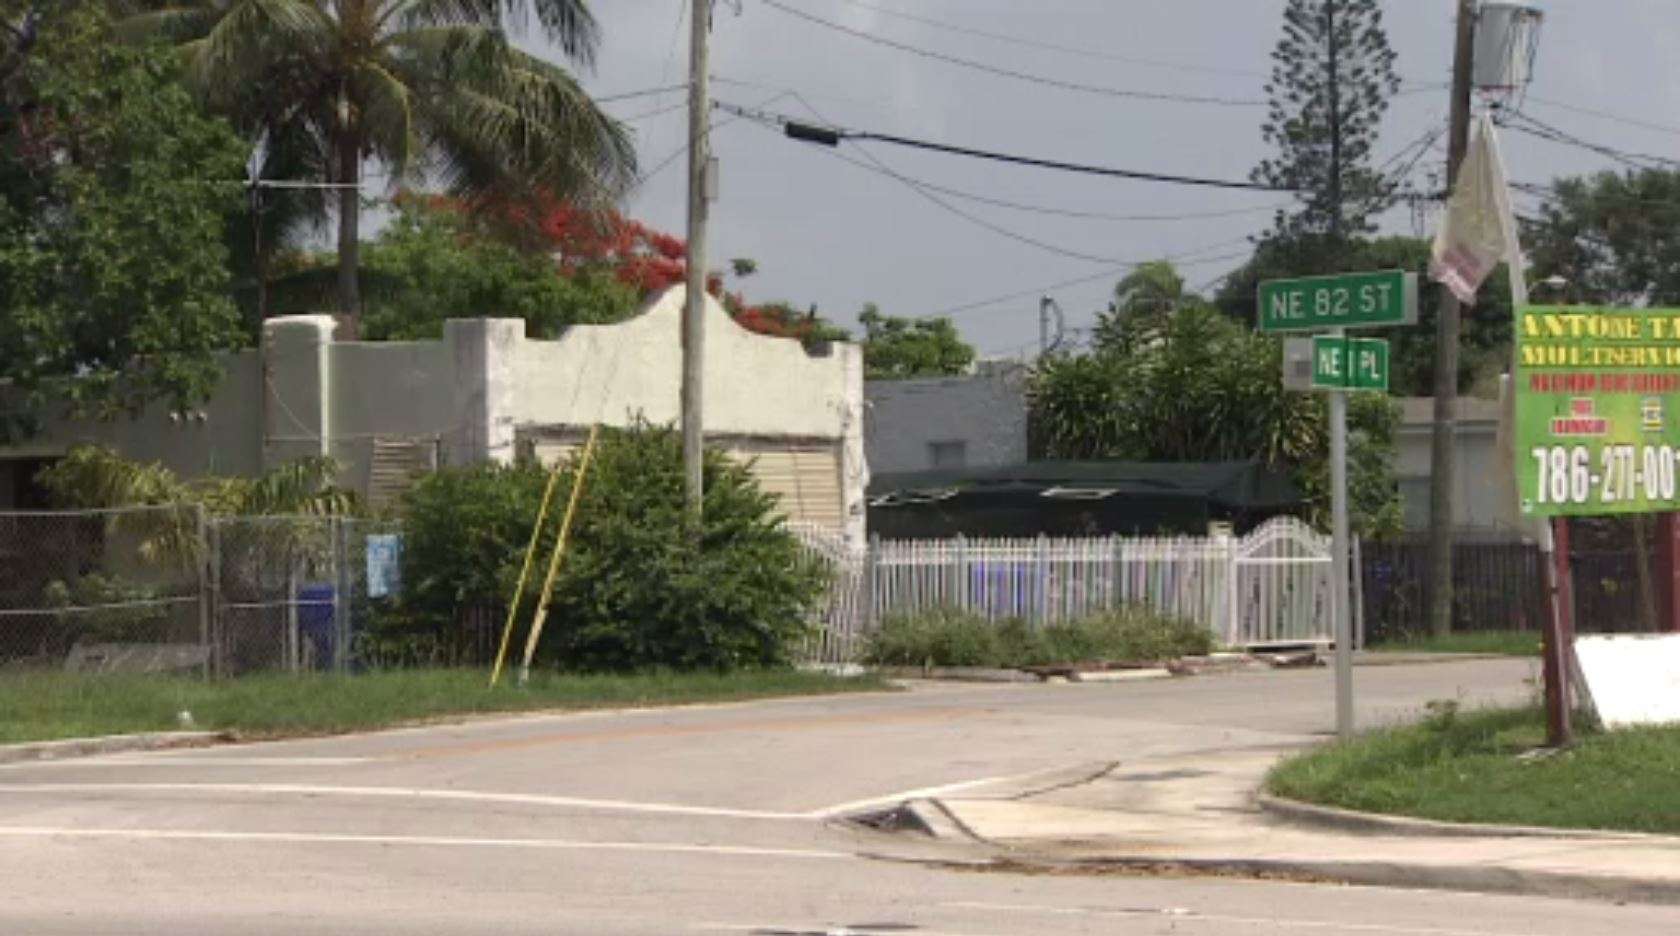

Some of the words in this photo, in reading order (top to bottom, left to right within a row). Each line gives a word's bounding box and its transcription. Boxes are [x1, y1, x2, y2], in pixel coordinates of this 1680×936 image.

[1271, 291, 1305, 320] NE
[1315, 288, 1350, 317] 82
[1359, 282, 1392, 313] ST
[1318, 347, 1341, 377] NE
[1360, 350, 1381, 380] PL
